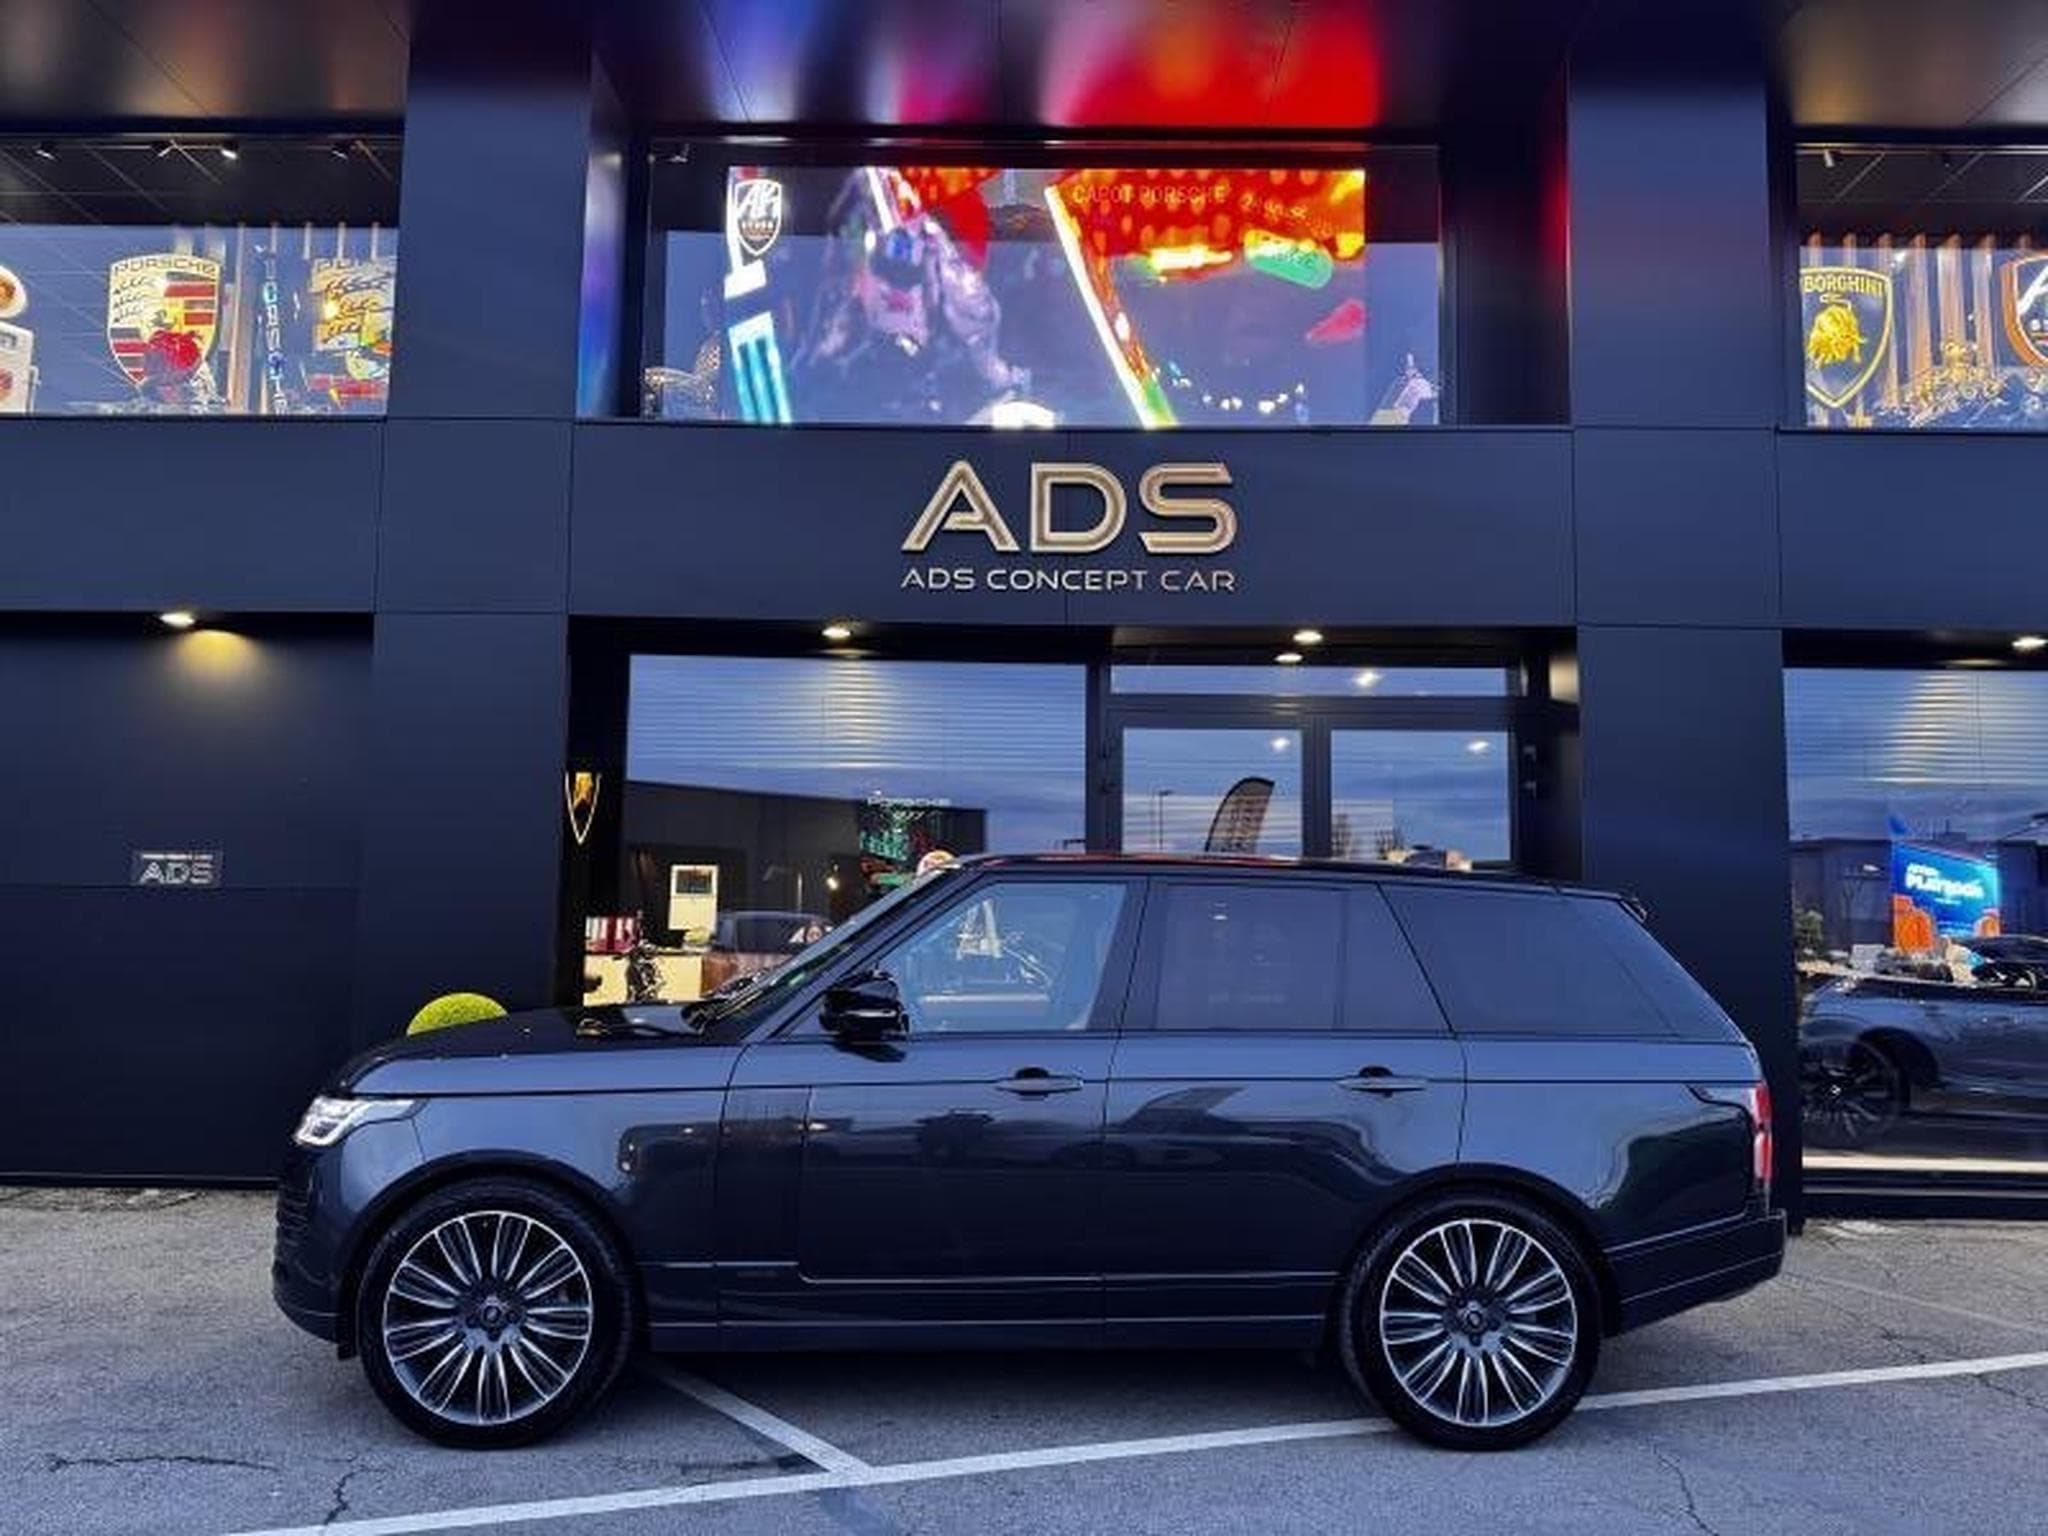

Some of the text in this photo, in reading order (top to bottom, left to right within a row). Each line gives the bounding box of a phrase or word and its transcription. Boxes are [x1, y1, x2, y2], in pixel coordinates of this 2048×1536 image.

[1803, 273, 1883, 296] BORGHINI
[901, 459, 1238, 555] ADS
[901, 567, 1237, 592] ADS CONCEPT CAR
[139, 861, 214, 885] ADS
